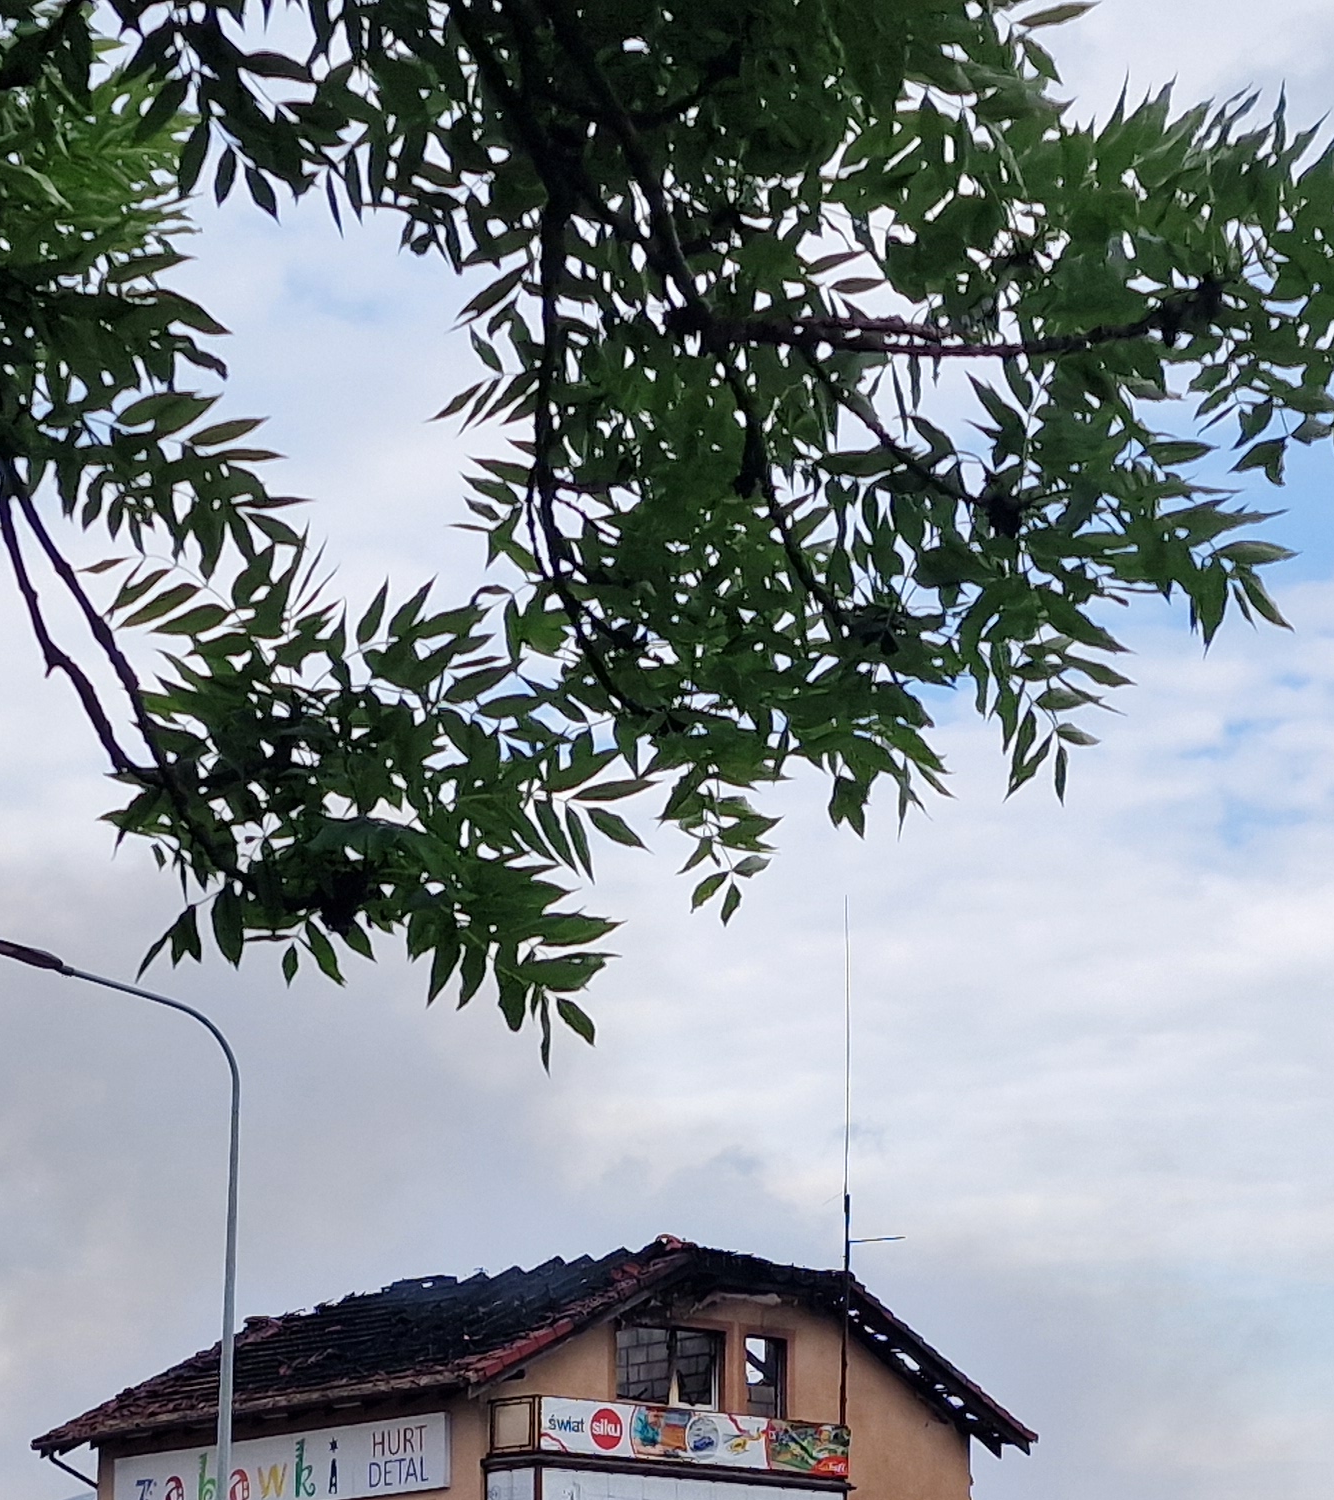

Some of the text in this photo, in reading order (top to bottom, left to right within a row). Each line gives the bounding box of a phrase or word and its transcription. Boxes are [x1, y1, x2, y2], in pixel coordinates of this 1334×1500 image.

[372, 1425, 428, 1457] HURT
[548, 1414, 621, 1437] świat siku
[368, 1456, 429, 1488] DETAL
